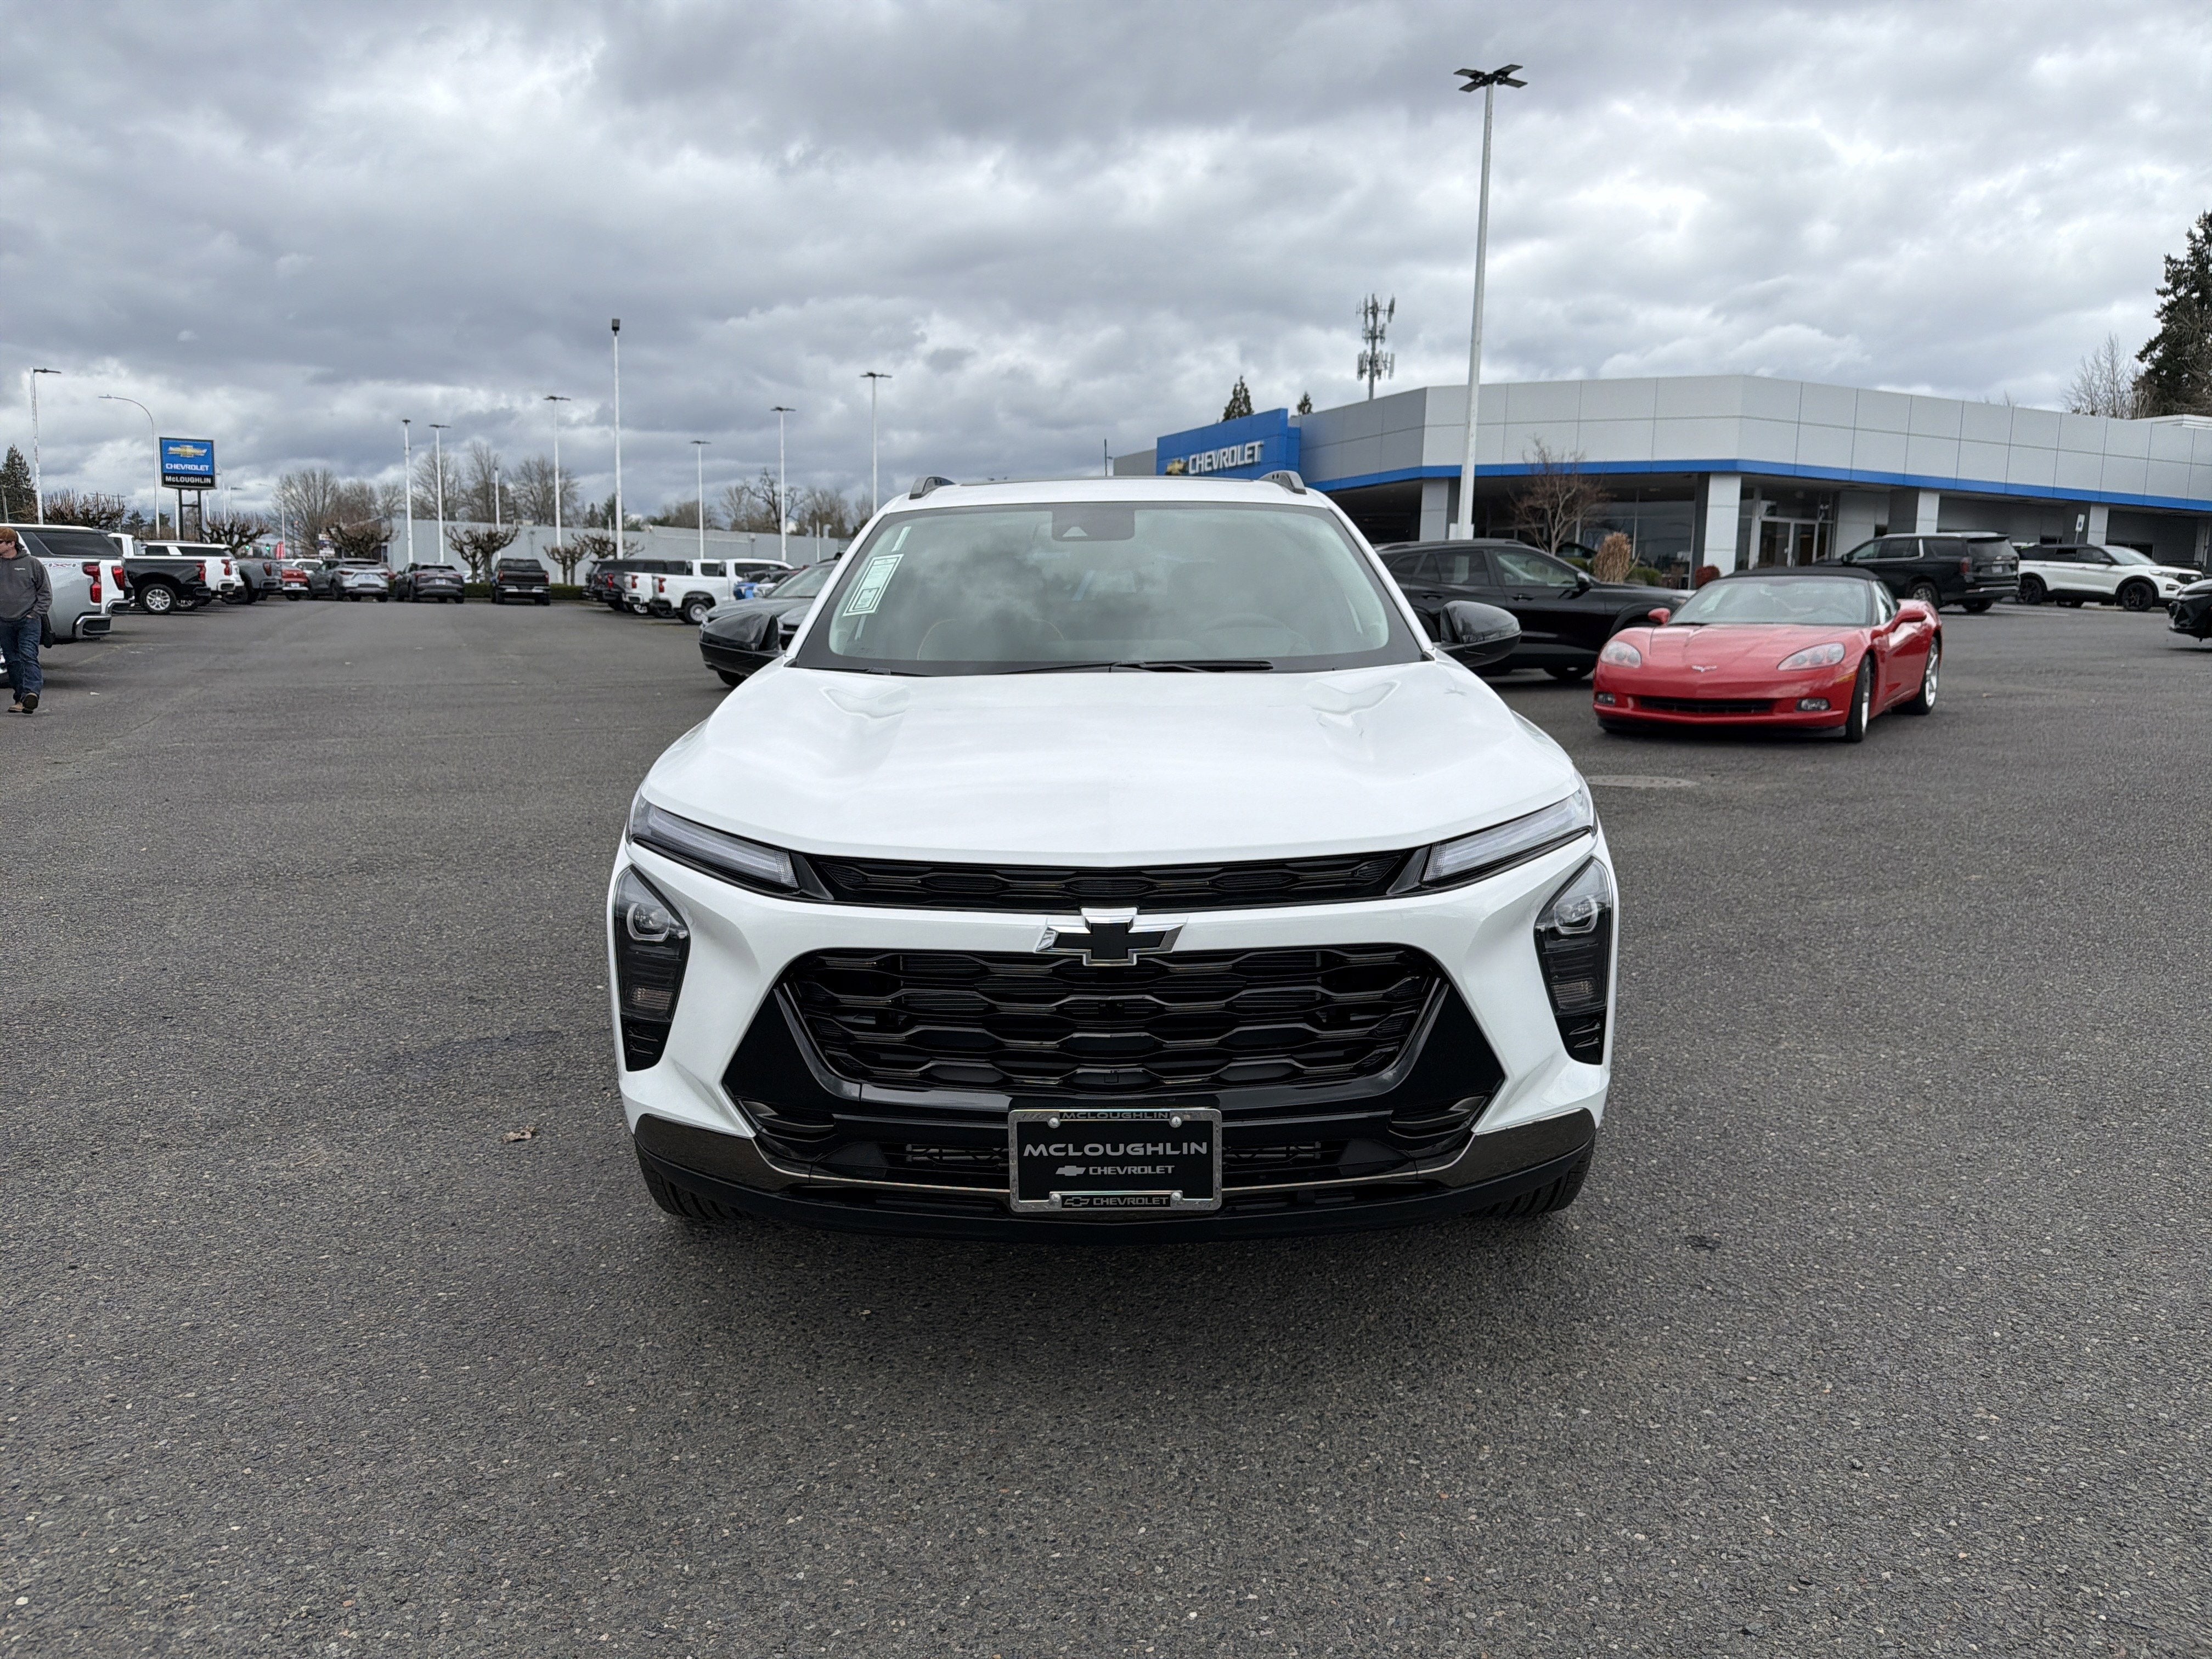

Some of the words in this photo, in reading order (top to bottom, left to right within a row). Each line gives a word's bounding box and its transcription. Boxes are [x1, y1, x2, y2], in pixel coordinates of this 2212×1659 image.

[1188, 441, 1263, 475] CHEVROLET
[1089, 1165, 1175, 1175] CHEVROLET
[1093, 1197, 1169, 1205] CHEVROLET
